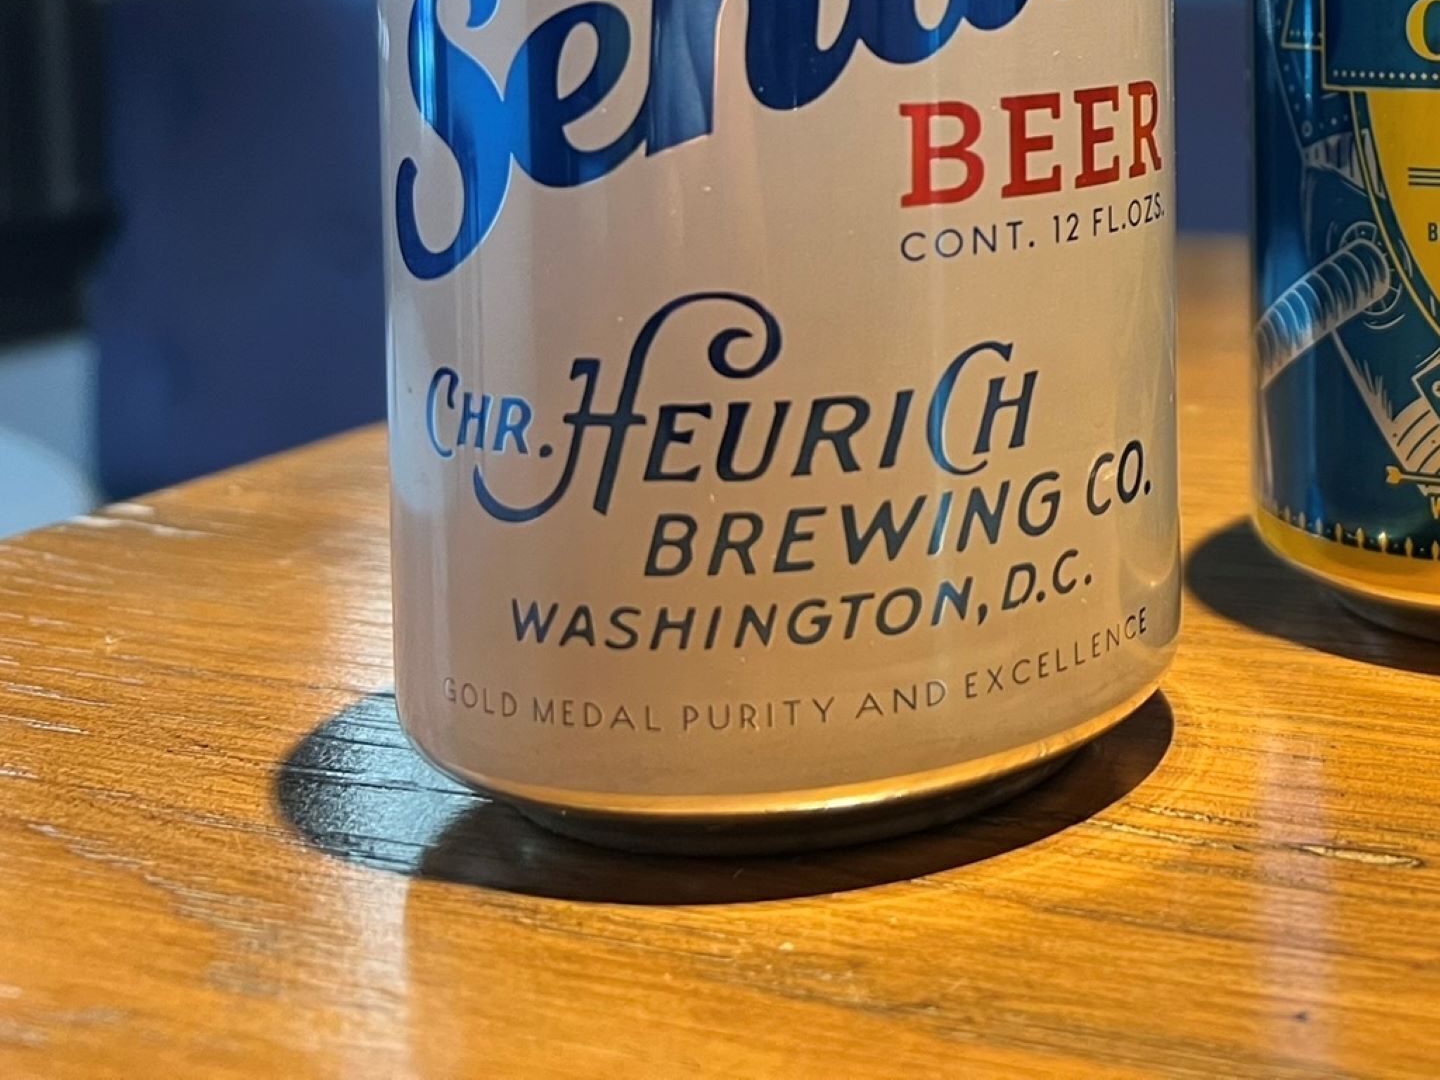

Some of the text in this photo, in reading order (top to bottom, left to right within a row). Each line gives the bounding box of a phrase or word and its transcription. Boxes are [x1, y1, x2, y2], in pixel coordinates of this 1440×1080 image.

[899, 80, 1162, 209] BEER
[900, 221, 1035, 262] CONT.
[1052, 212, 1080, 244] 12
[473, 291, 1038, 522] HEURICH
[643, 438, 1152, 578] BREWING CO.
[511, 548, 1093, 650] WASHINGTON, D.C.
[443, 606, 1148, 732] GOLD MEDAL PURITY AND EXCELLENCE
